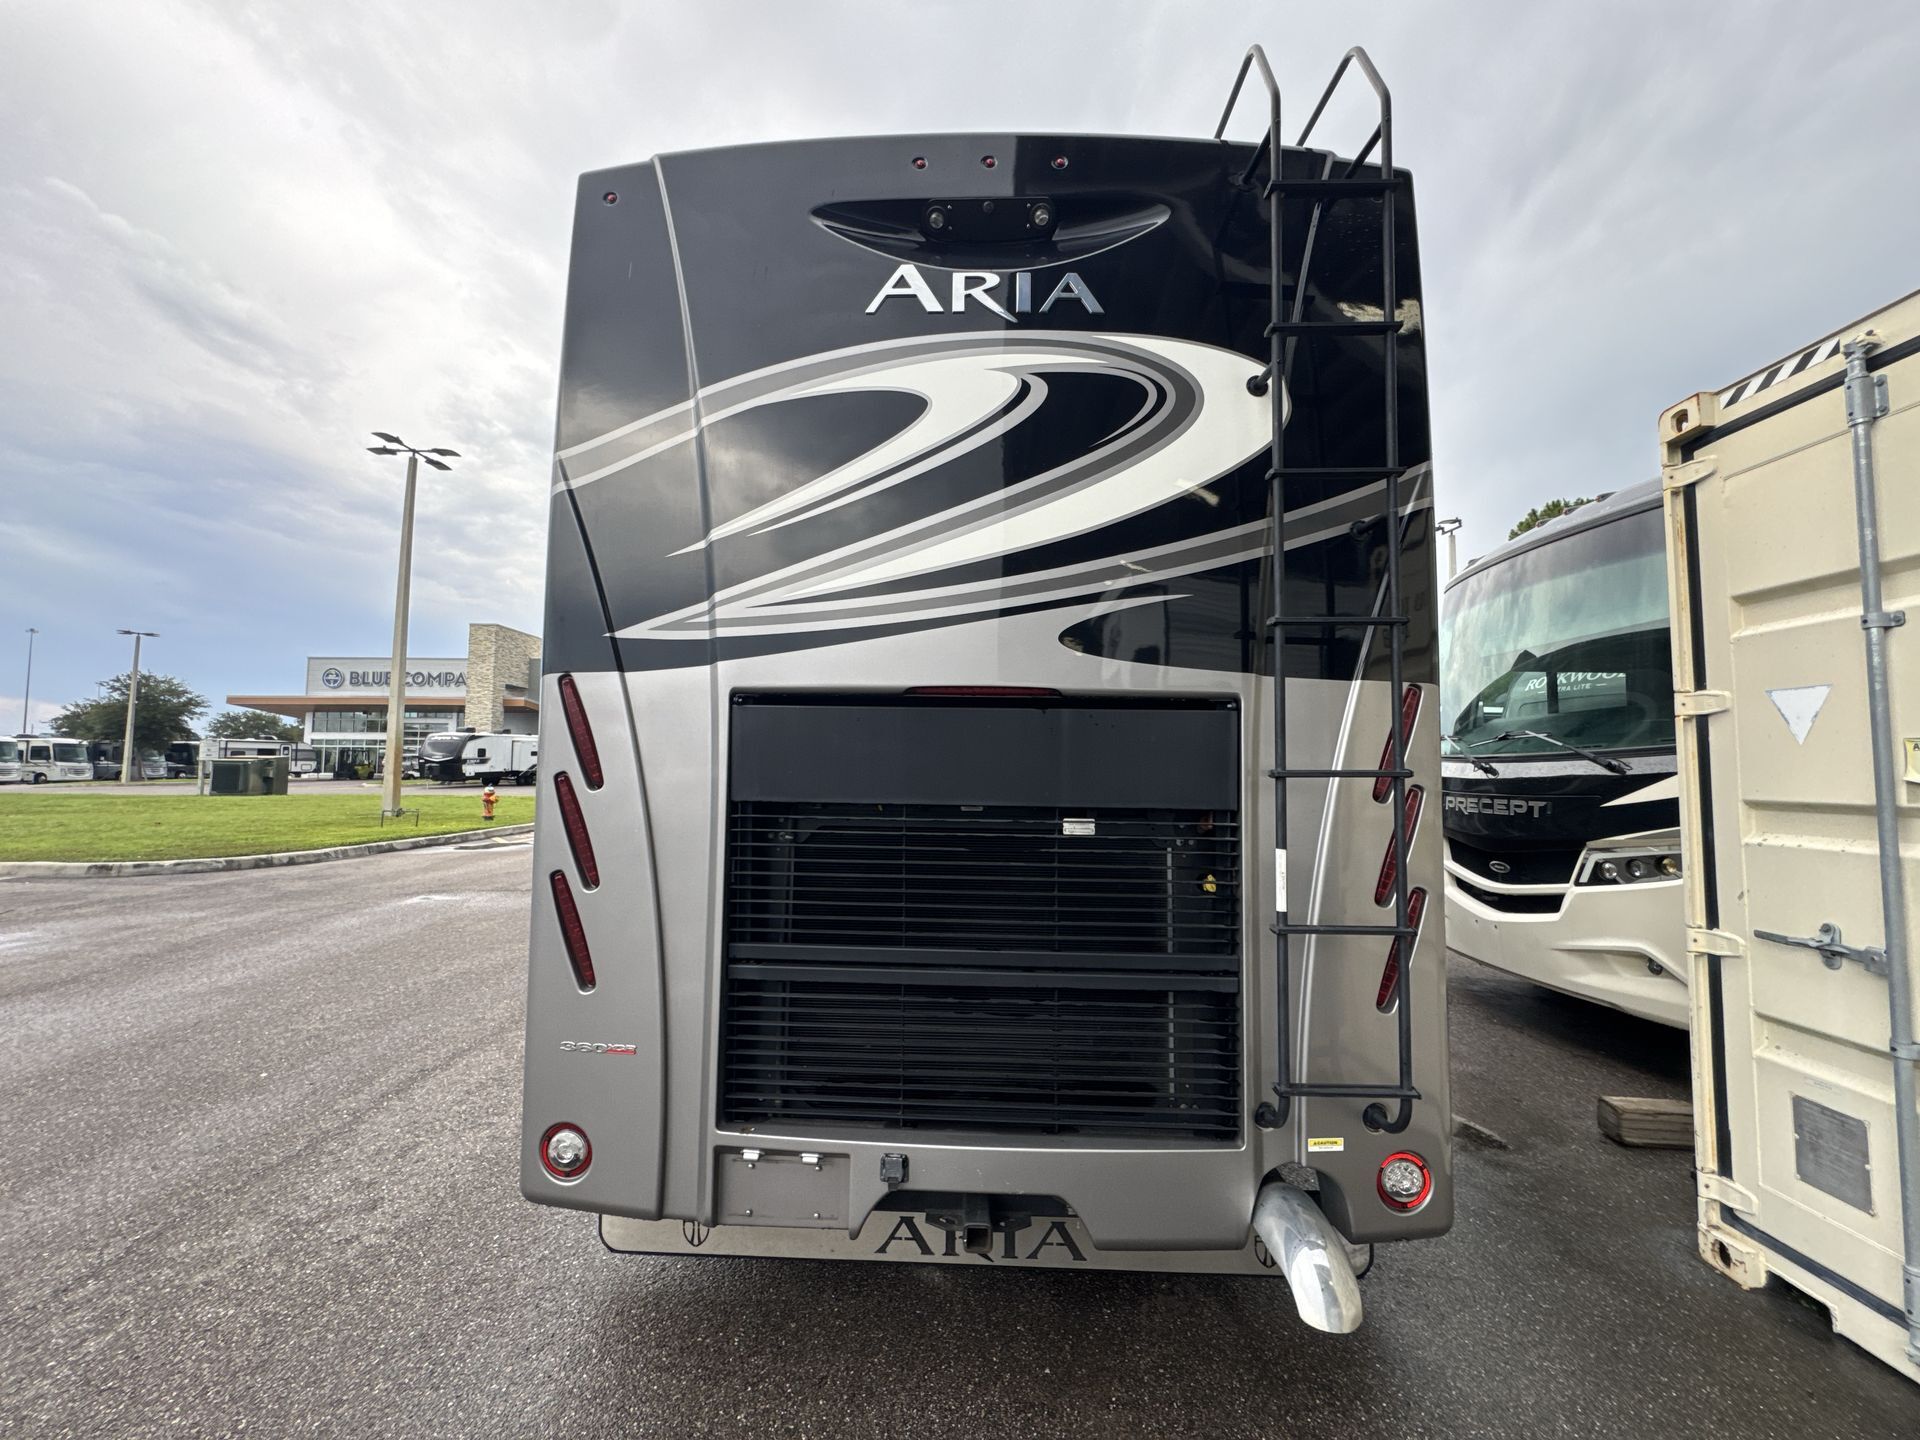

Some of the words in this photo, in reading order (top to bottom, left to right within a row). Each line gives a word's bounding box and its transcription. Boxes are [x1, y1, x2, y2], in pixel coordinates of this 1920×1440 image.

[865, 264, 1105, 323] ARIA
[1445, 796, 1548, 818] PRECEPT
[874, 1215, 1088, 1263] AIA
